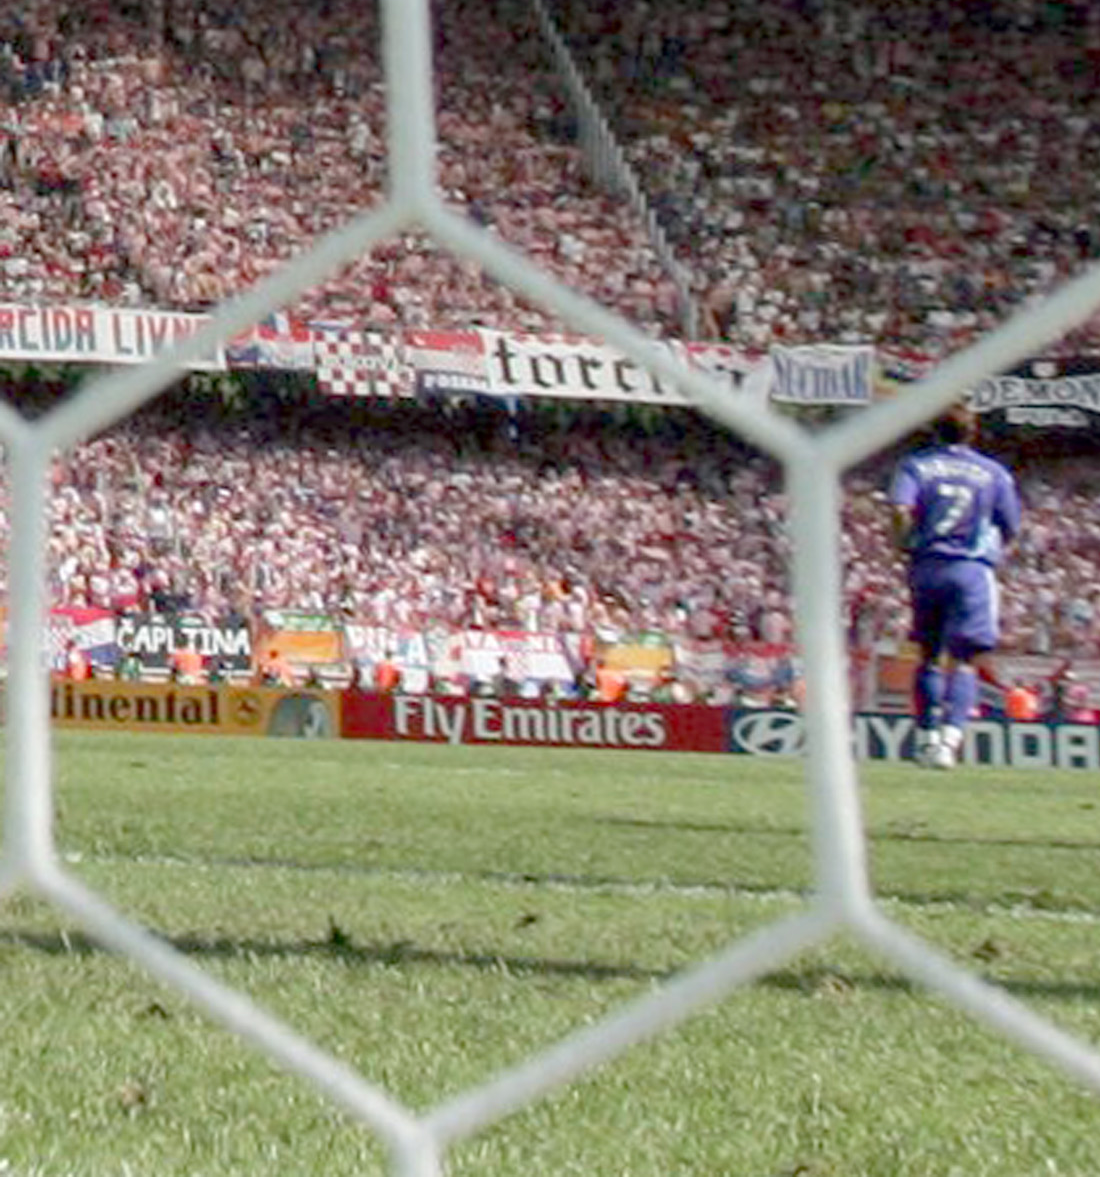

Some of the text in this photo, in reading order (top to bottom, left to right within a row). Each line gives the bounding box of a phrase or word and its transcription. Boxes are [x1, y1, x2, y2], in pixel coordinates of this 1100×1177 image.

[112, 312, 214, 357] LIVN
[393, 695, 667, 747] Fly Emirates
